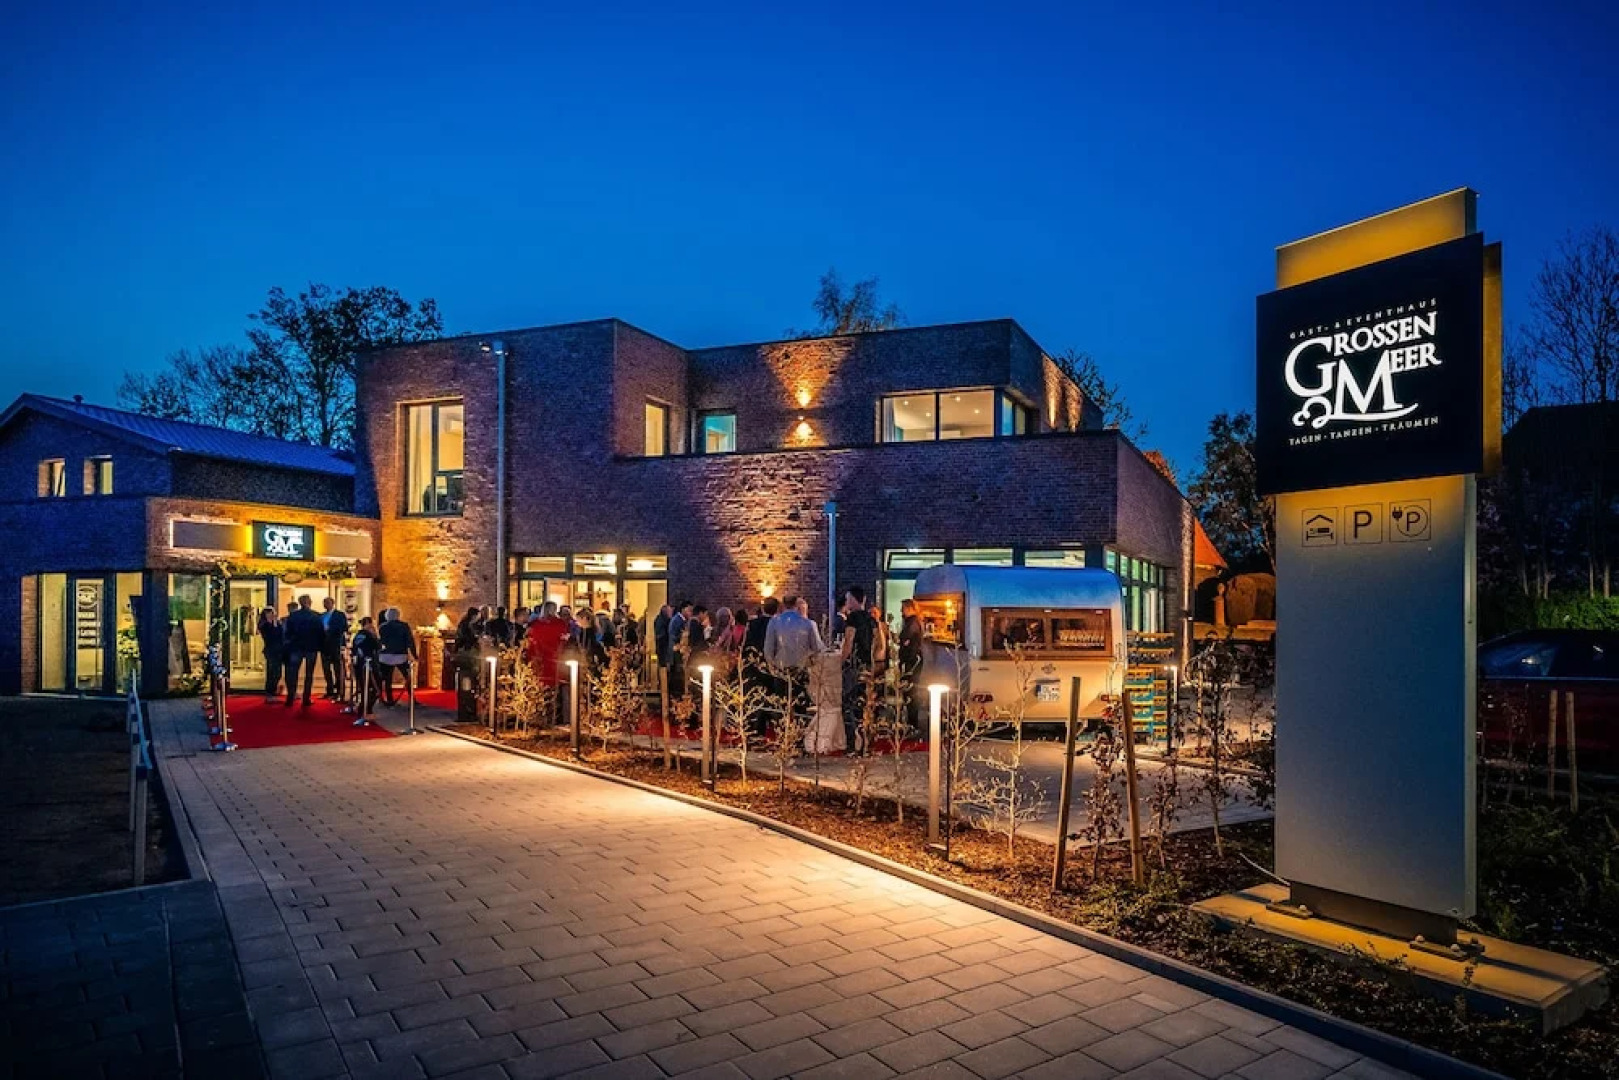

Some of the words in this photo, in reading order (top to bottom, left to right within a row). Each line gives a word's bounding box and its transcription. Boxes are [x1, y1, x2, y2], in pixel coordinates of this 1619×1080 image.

[1285, 311, 1438, 397] GROSSEN
[1336, 342, 1442, 416] MEER
[1289, 433, 1322, 446] TAGEN
[1329, 425, 1372, 440] TANZEN
